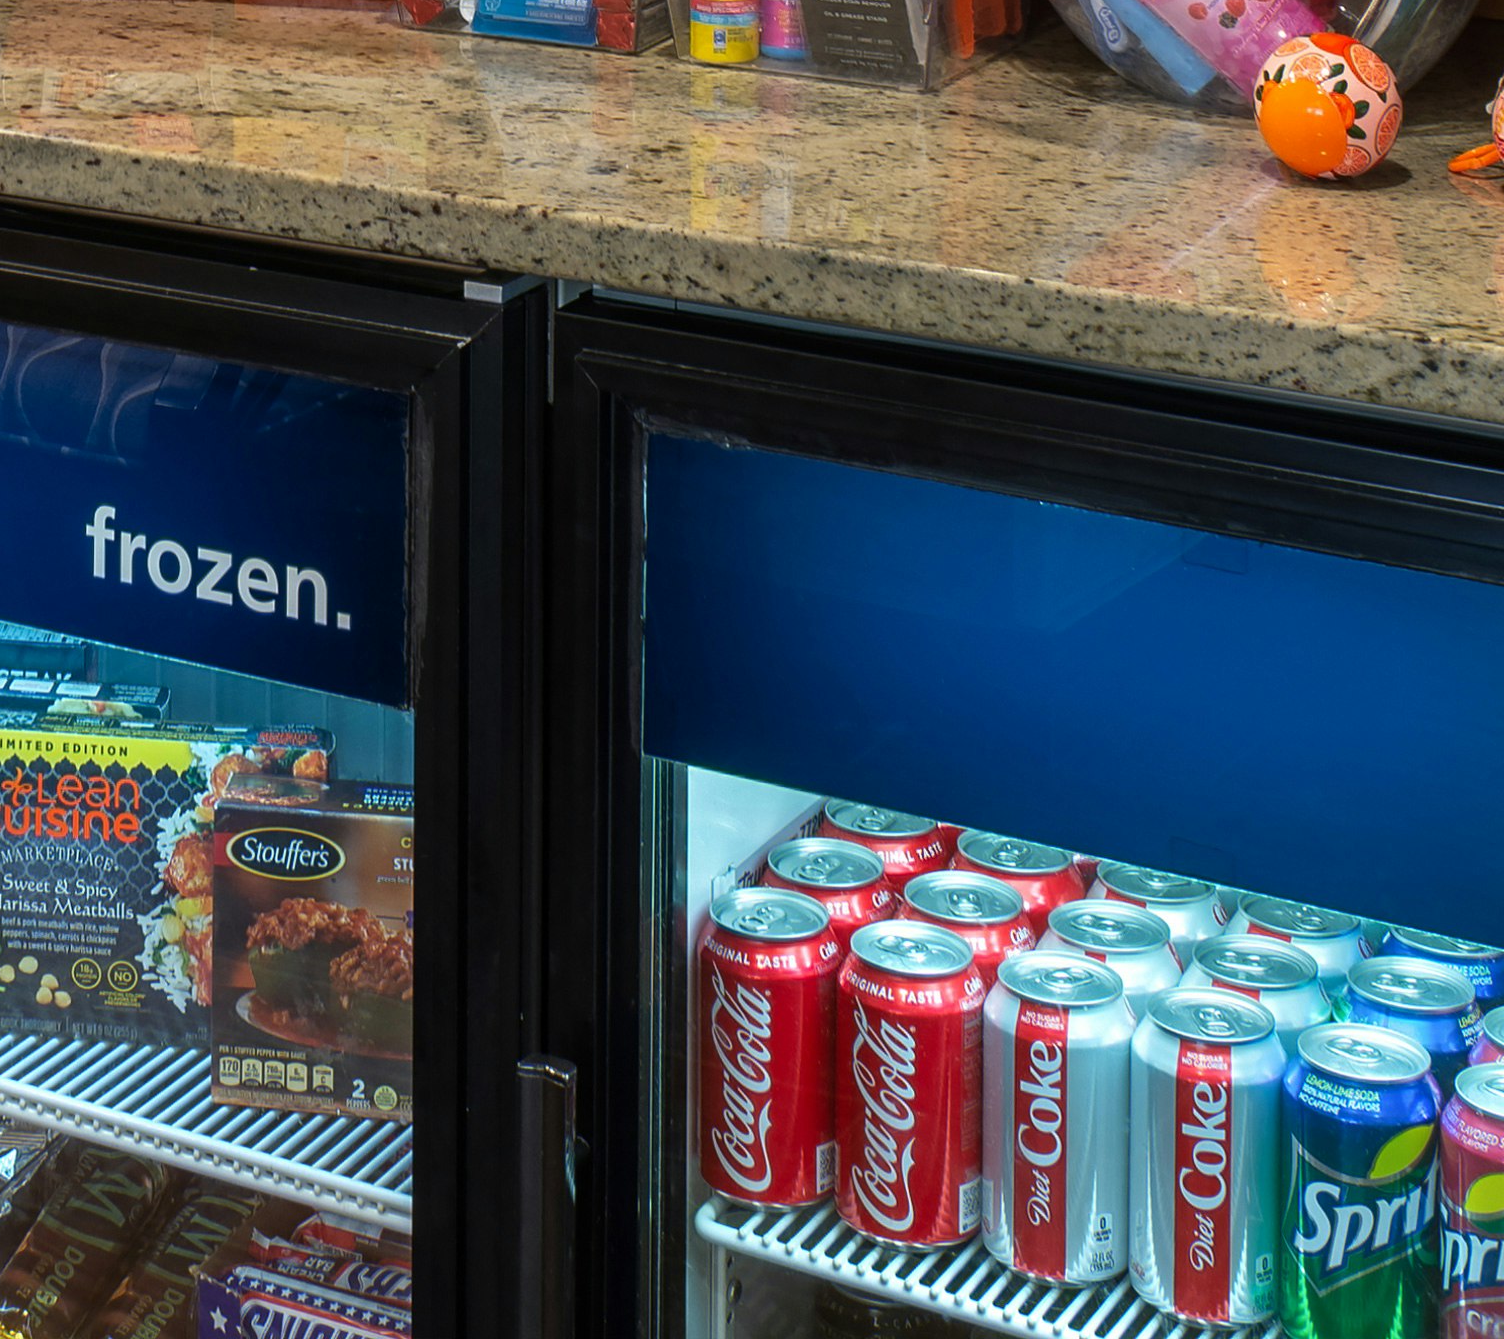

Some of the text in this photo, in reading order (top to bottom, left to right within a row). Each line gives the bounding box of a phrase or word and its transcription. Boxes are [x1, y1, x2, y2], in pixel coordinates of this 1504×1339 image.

[86, 505, 352, 631] frozen.
[61, 739, 130, 758] EDITION
[0, 843, 116, 873] MARKETPLACE
[239, 836, 330, 872] Stouffer's
[2, 872, 119, 901] Sweet & Spicy
[52, 895, 135, 921] Meatballs
[754, 953, 797, 969] TASTE
[114, 971, 132, 983] NO
[899, 988, 942, 1005] TASTE
[1036, 1018, 1065, 1032] CALORIES
[222, 1058, 239, 1073] 170
[351, 1078, 366, 1100] 2
[1353, 1090, 1381, 1103] SODA
[1017, 1037, 1064, 1168] Coke
[1348, 1100, 1381, 1113] FLAVORS
[1178, 1079, 1228, 1212] Coke
